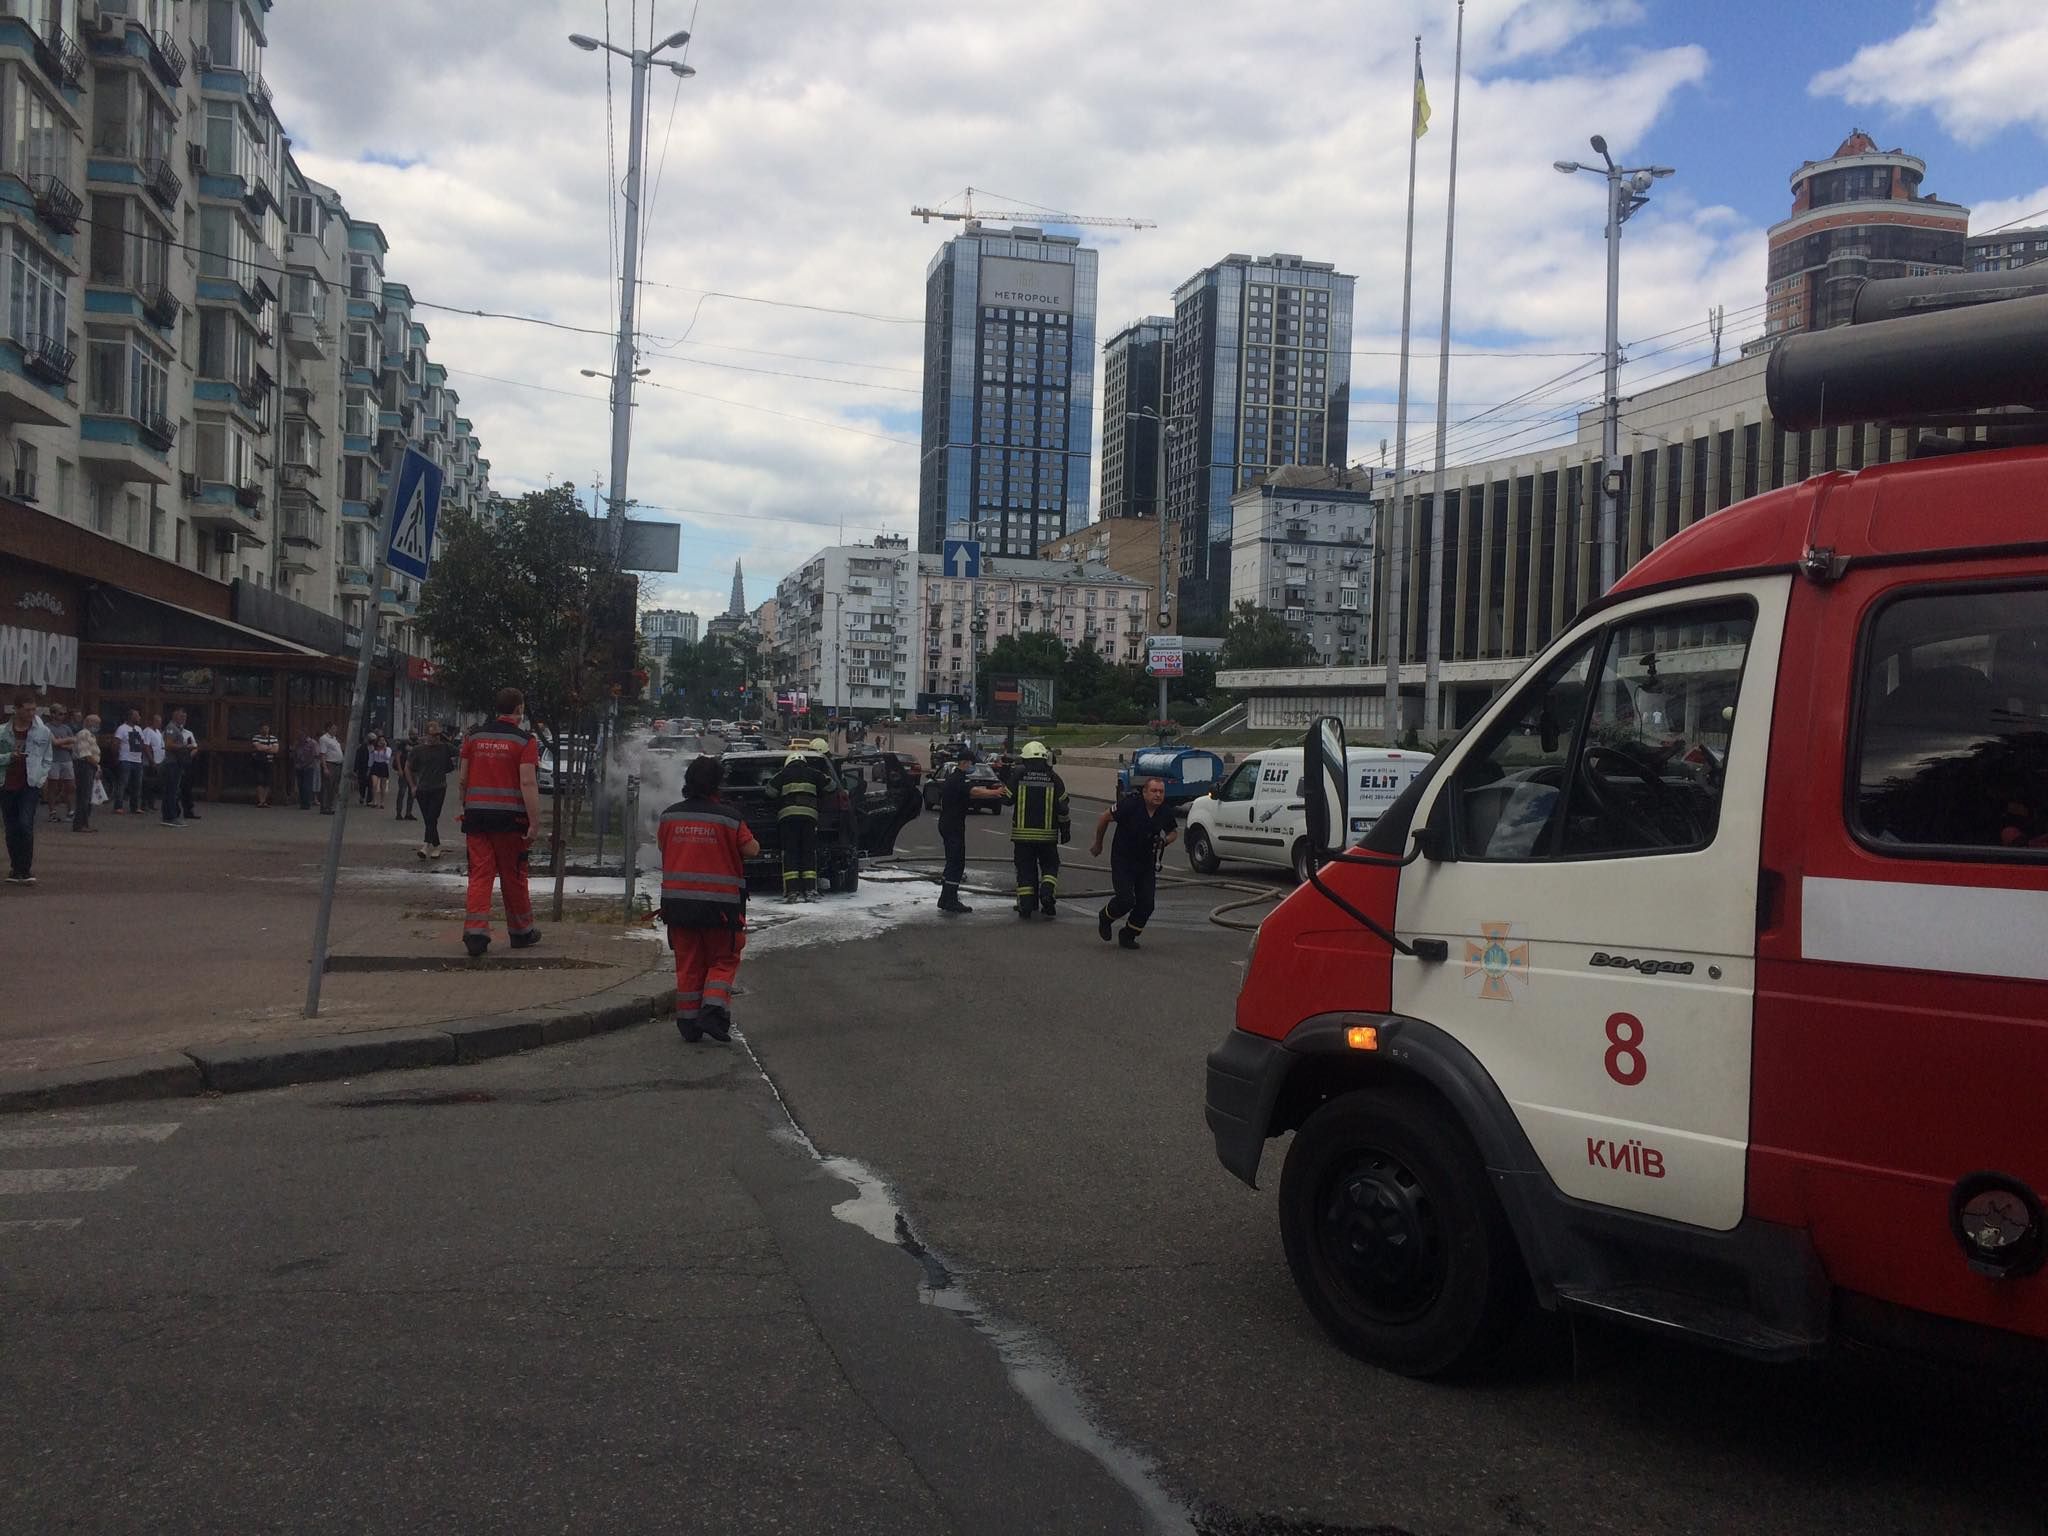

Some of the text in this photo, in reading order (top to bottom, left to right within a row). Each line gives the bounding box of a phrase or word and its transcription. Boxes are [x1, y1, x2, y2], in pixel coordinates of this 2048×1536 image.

[995, 291, 1060, 305] METROPOLE
[1152, 655, 1181, 663] anex
[675, 826, 717, 836] ЕКСТРЕНА
[1589, 952, 1695, 975] Валдай
[1604, 1012, 1647, 1086] 8
[1586, 1137, 1666, 1179] КИЇВ
